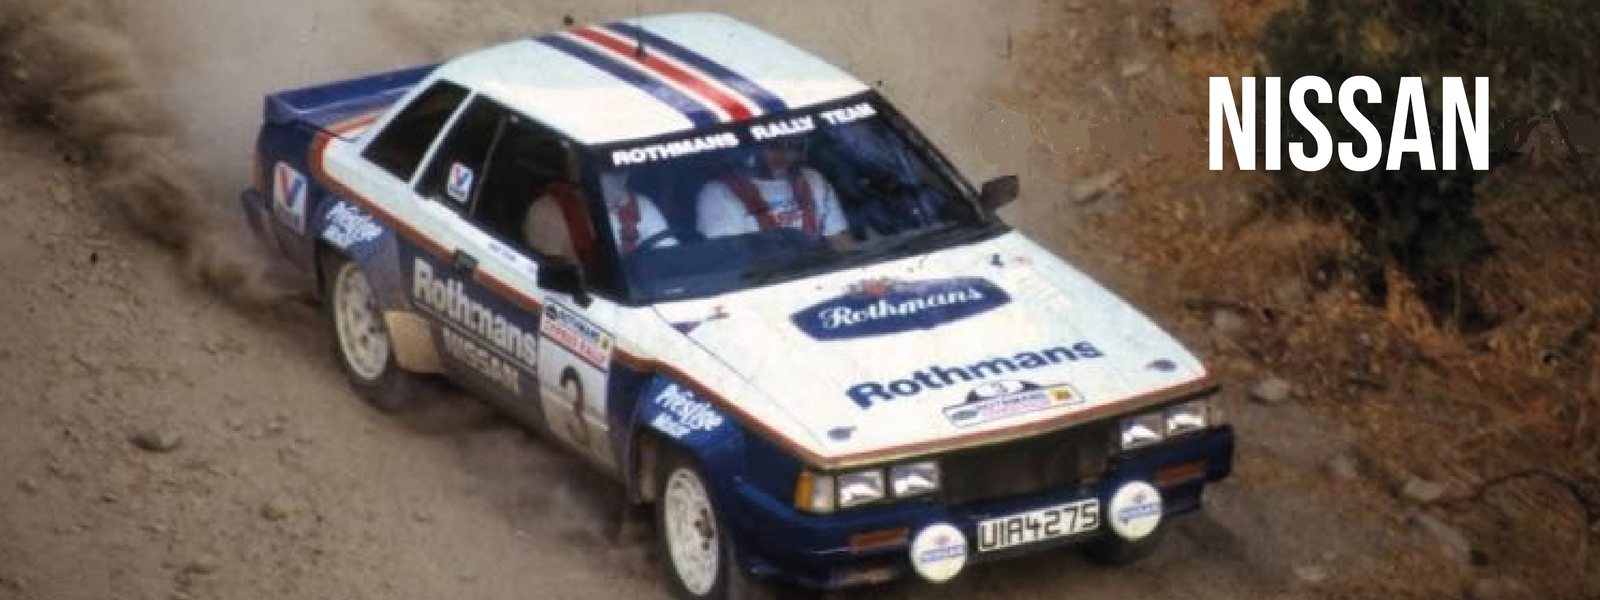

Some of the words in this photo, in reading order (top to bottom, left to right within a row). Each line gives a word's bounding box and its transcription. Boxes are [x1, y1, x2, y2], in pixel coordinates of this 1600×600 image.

[611, 131, 740, 168] ROTHMANS
[750, 114, 816, 141] RALLY
[819, 101, 878, 126] TEAM
[413, 256, 538, 367] Rothmans
[817, 285, 984, 329] Rothmans
[441, 326, 520, 394] NISSAN
[845, 340, 1104, 410] Rothmans
[980, 502, 1099, 550] UIA4275
